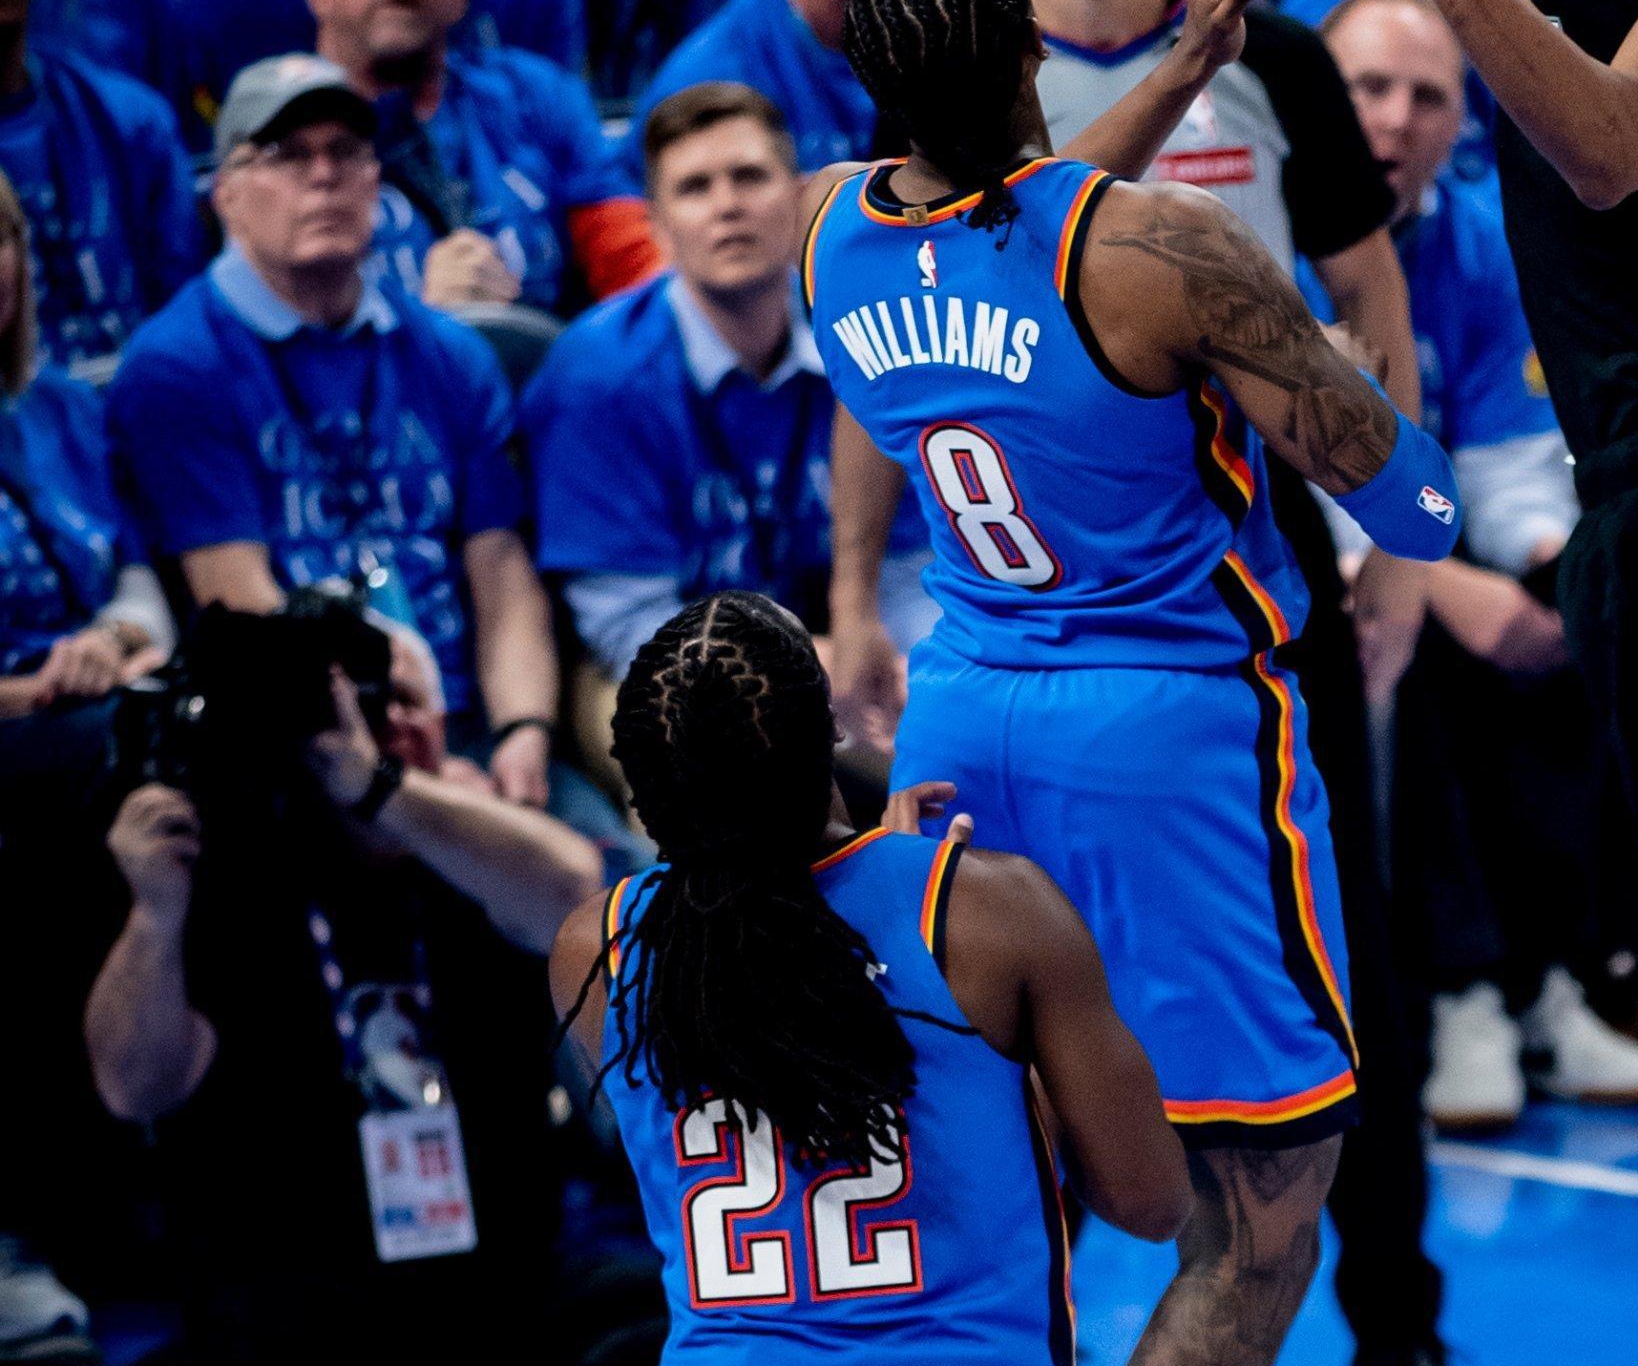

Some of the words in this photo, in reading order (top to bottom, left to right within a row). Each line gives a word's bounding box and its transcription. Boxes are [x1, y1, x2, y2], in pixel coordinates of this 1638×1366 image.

[833, 294, 1040, 384] WILLIAMS
[917, 419, 1064, 592] 8
[671, 1088, 924, 1309] 22
